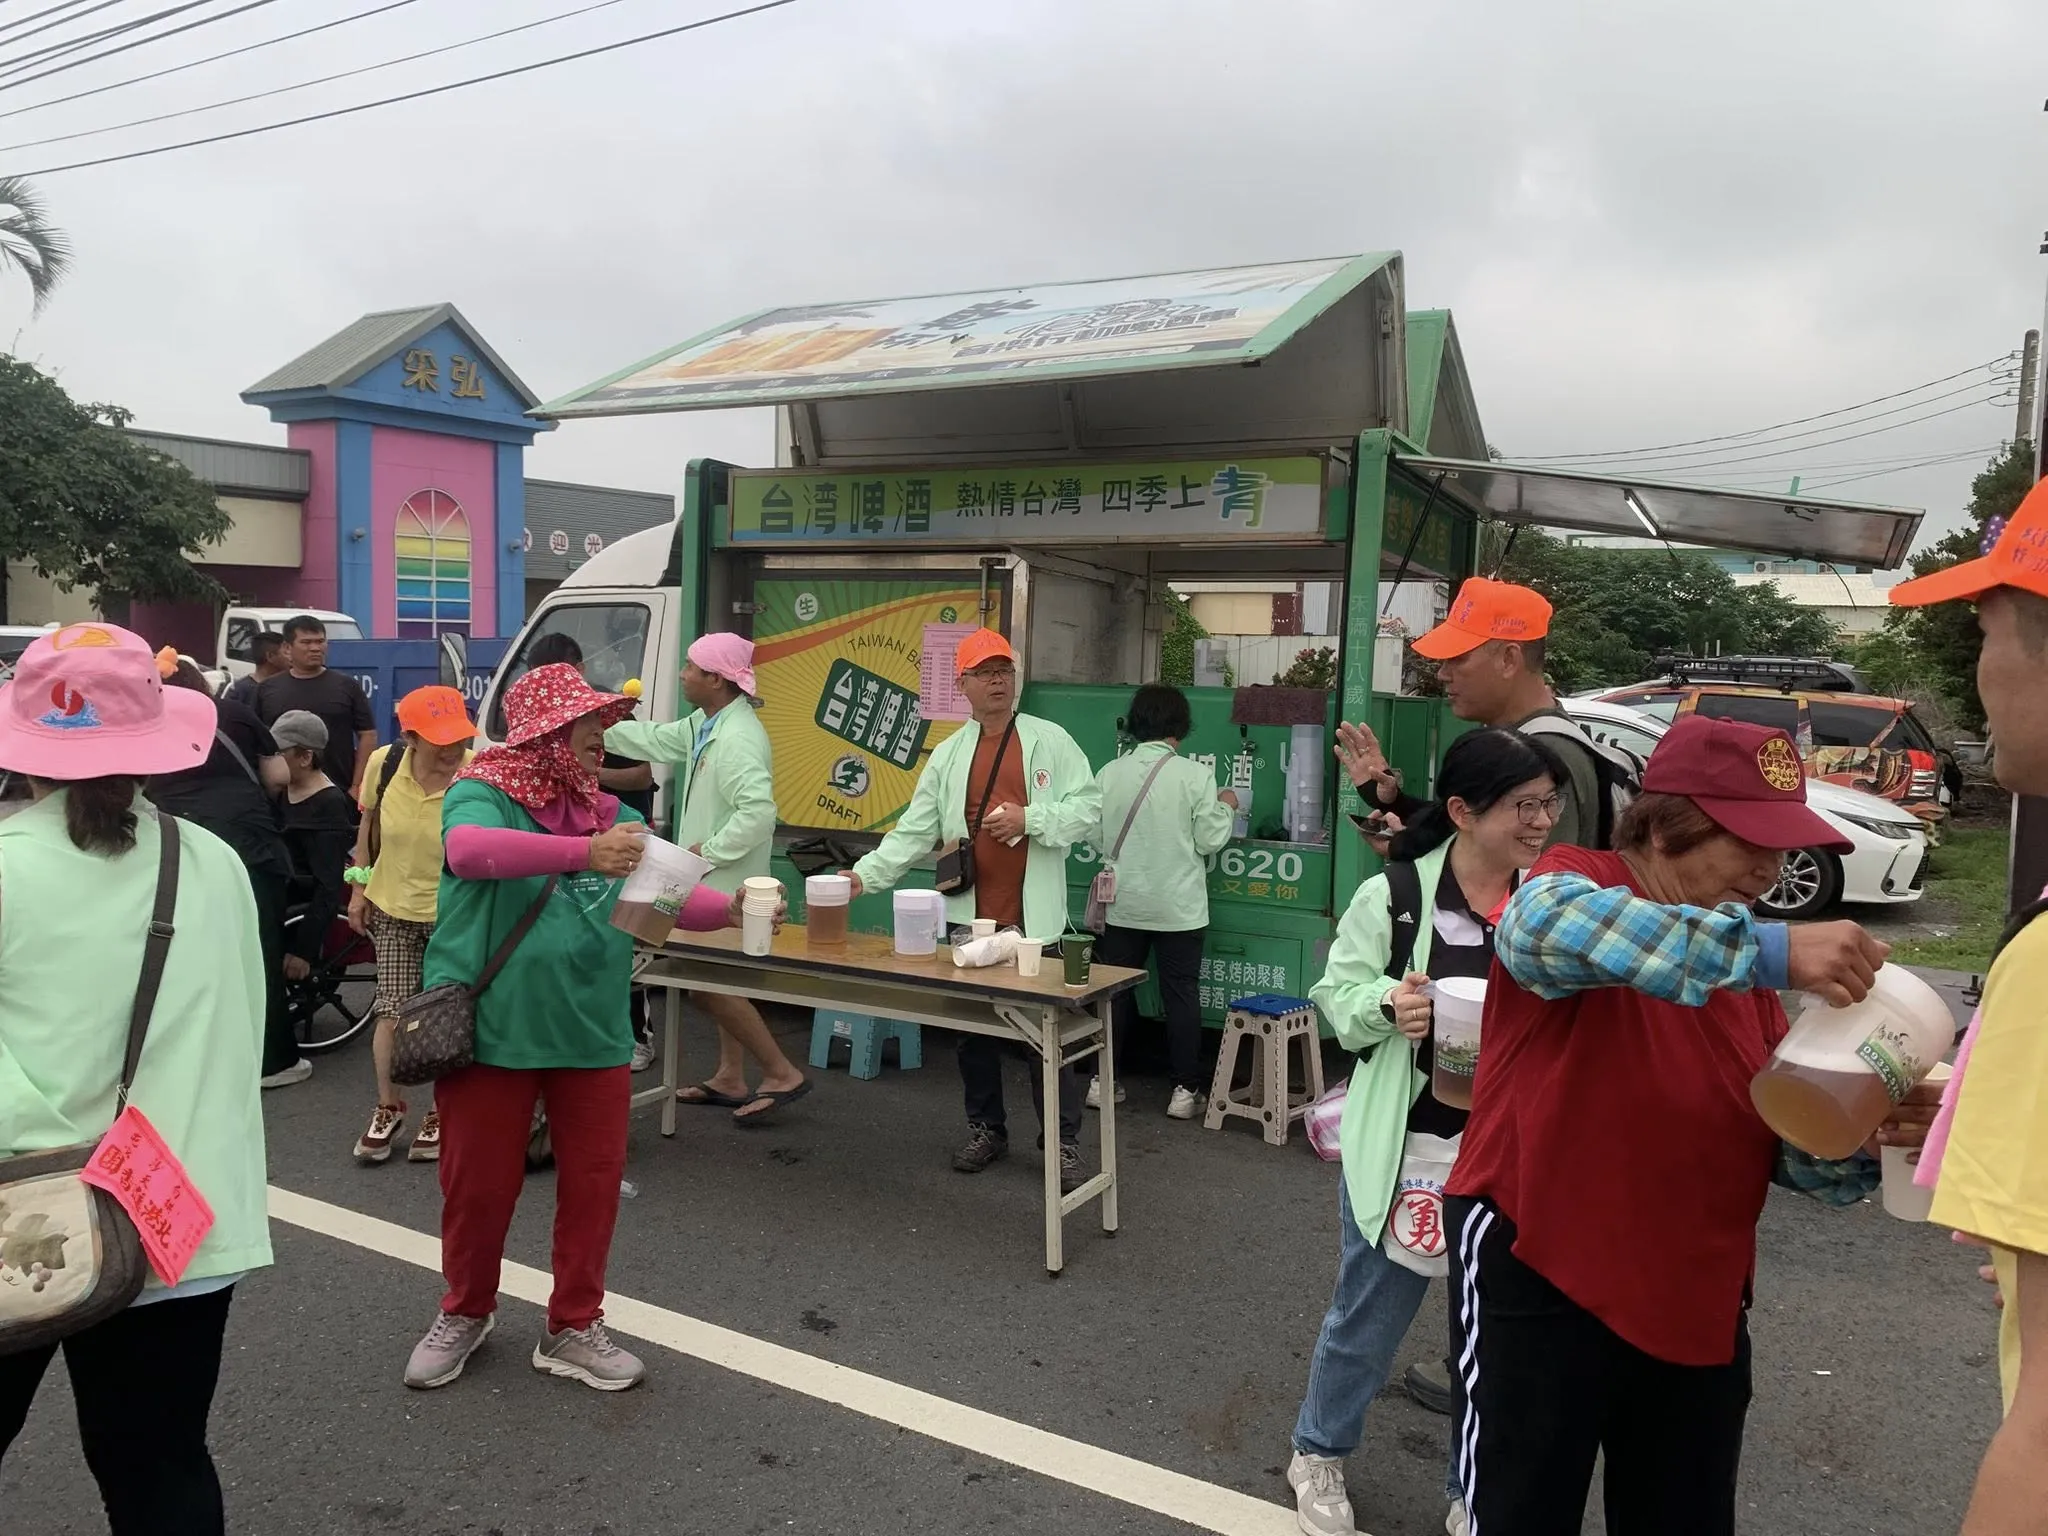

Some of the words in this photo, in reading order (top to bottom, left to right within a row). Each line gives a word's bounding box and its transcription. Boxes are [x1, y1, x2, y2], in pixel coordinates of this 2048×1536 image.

[956, 478, 1082, 518] 熱情台灣
[1102, 464, 1274, 529] 四季上青
[798, 597, 816, 617] 生
[847, 634, 907, 656] TAIWAN
[816, 794, 862, 824] DRAFT
[1406, 1198, 1442, 1253] 勇
